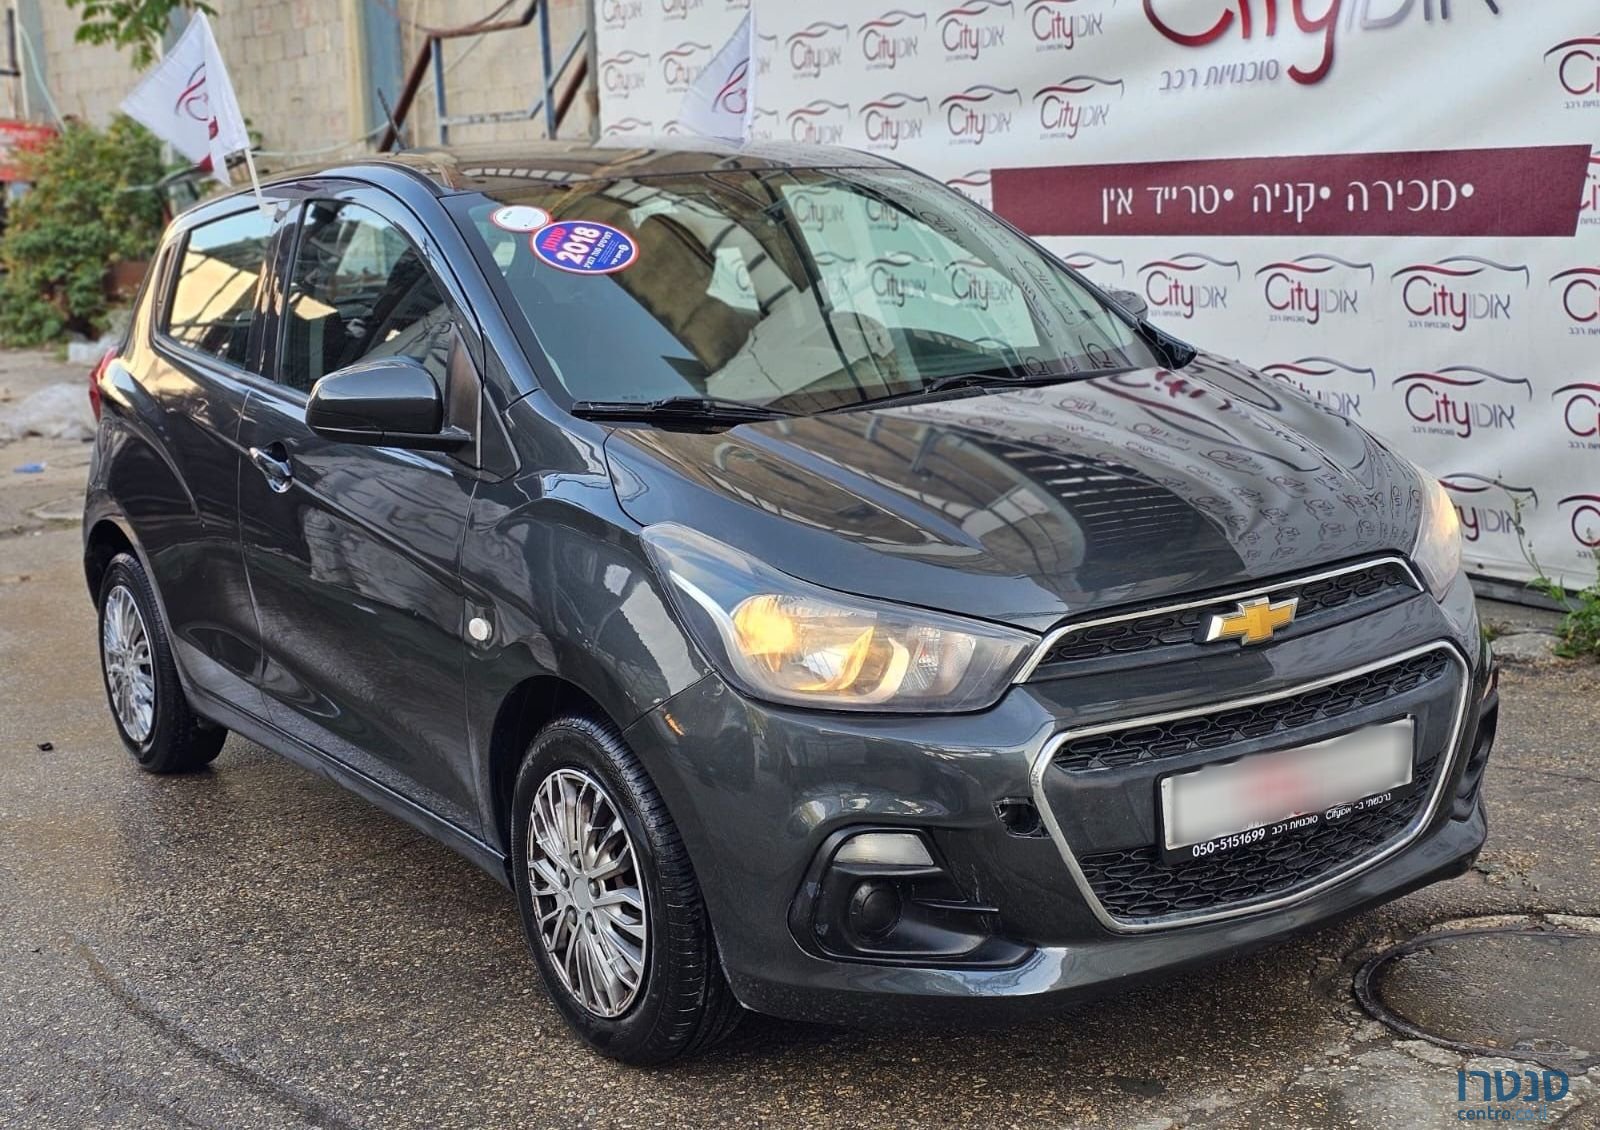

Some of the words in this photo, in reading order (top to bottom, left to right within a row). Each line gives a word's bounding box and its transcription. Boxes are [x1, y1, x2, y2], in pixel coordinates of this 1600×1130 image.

[942, 18, 980, 60] City
[1031, 5, 1074, 50] City
[1159, 68, 1199, 90] רכב
[1203, 59, 1280, 87] סוכנויות
[948, 103, 986, 145] City
[1041, 95, 1083, 139] City
[1102, 187, 1134, 225] אין
[556, 226, 600, 265] 2018
[1145, 270, 1193, 319] City
[1265, 272, 1319, 325] City
[1402, 275, 1467, 332] City
[1405, 383, 1471, 438] City
[1192, 828, 1266, 858] 050-5151699
[1272, 824, 1288, 836] רכב
